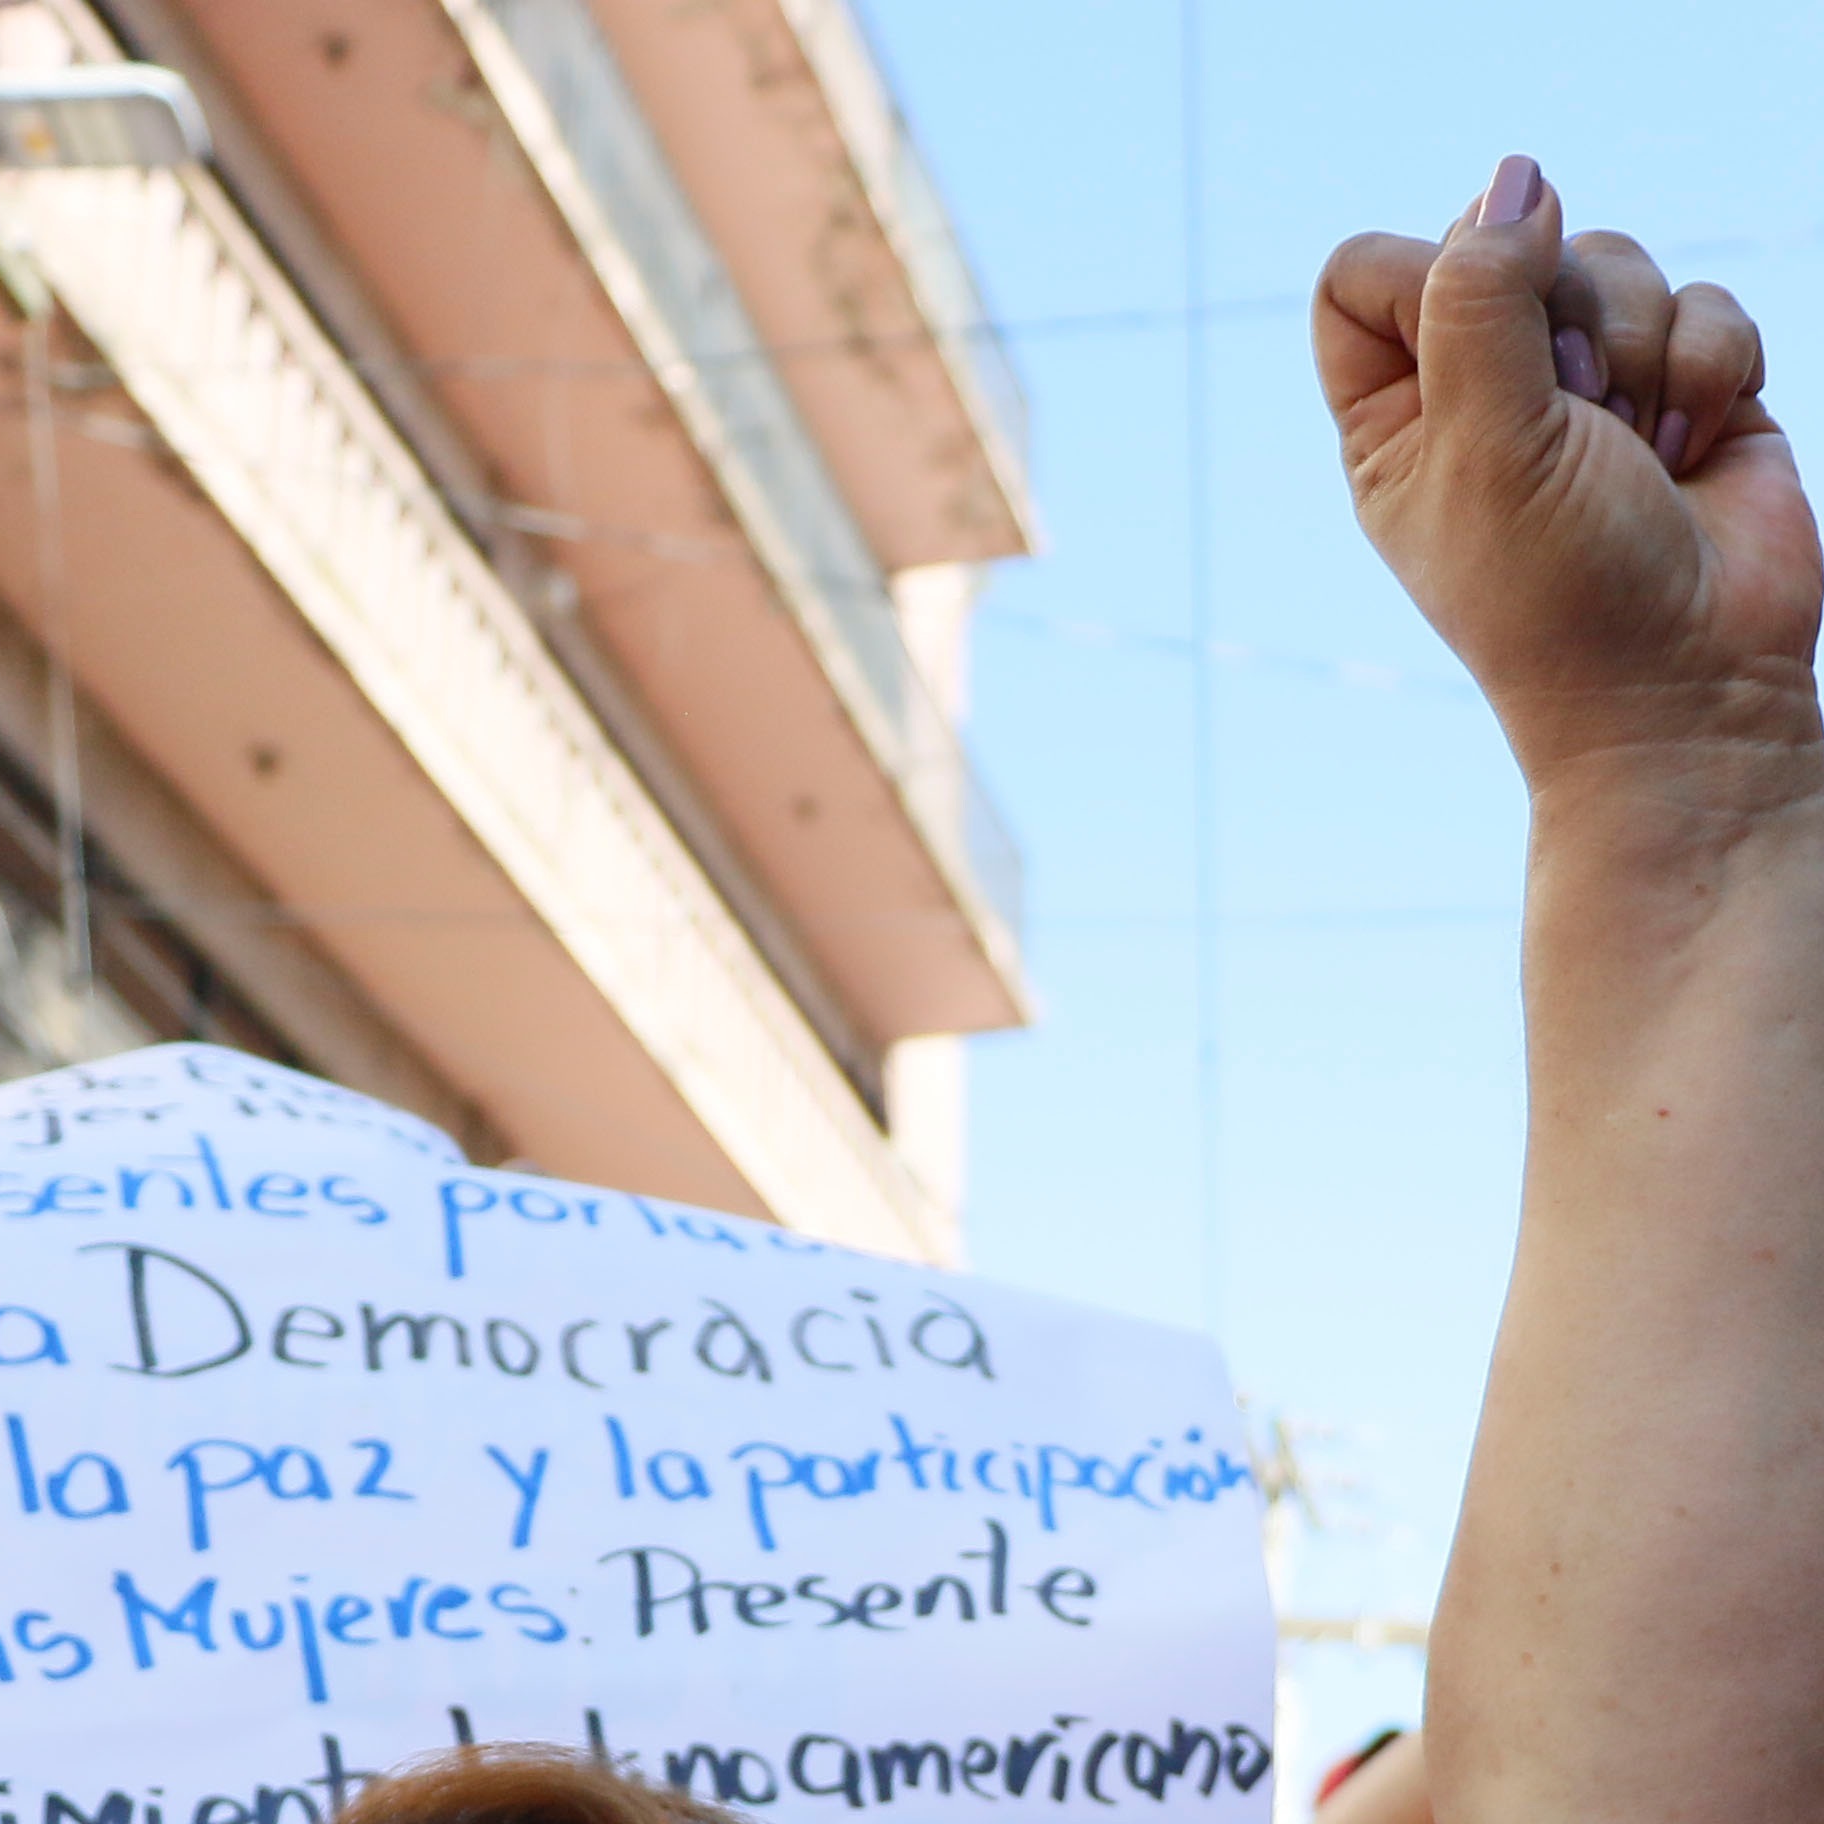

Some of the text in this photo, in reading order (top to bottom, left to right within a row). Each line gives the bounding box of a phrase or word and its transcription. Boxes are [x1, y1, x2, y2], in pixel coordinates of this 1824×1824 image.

[76, 1242, 998, 1388] Democracia
[5, 1413, 132, 1520] la
[167, 1440, 416, 1552] paz
[484, 1444, 548, 1548] y
[597, 1520, 1099, 1637] Presente
